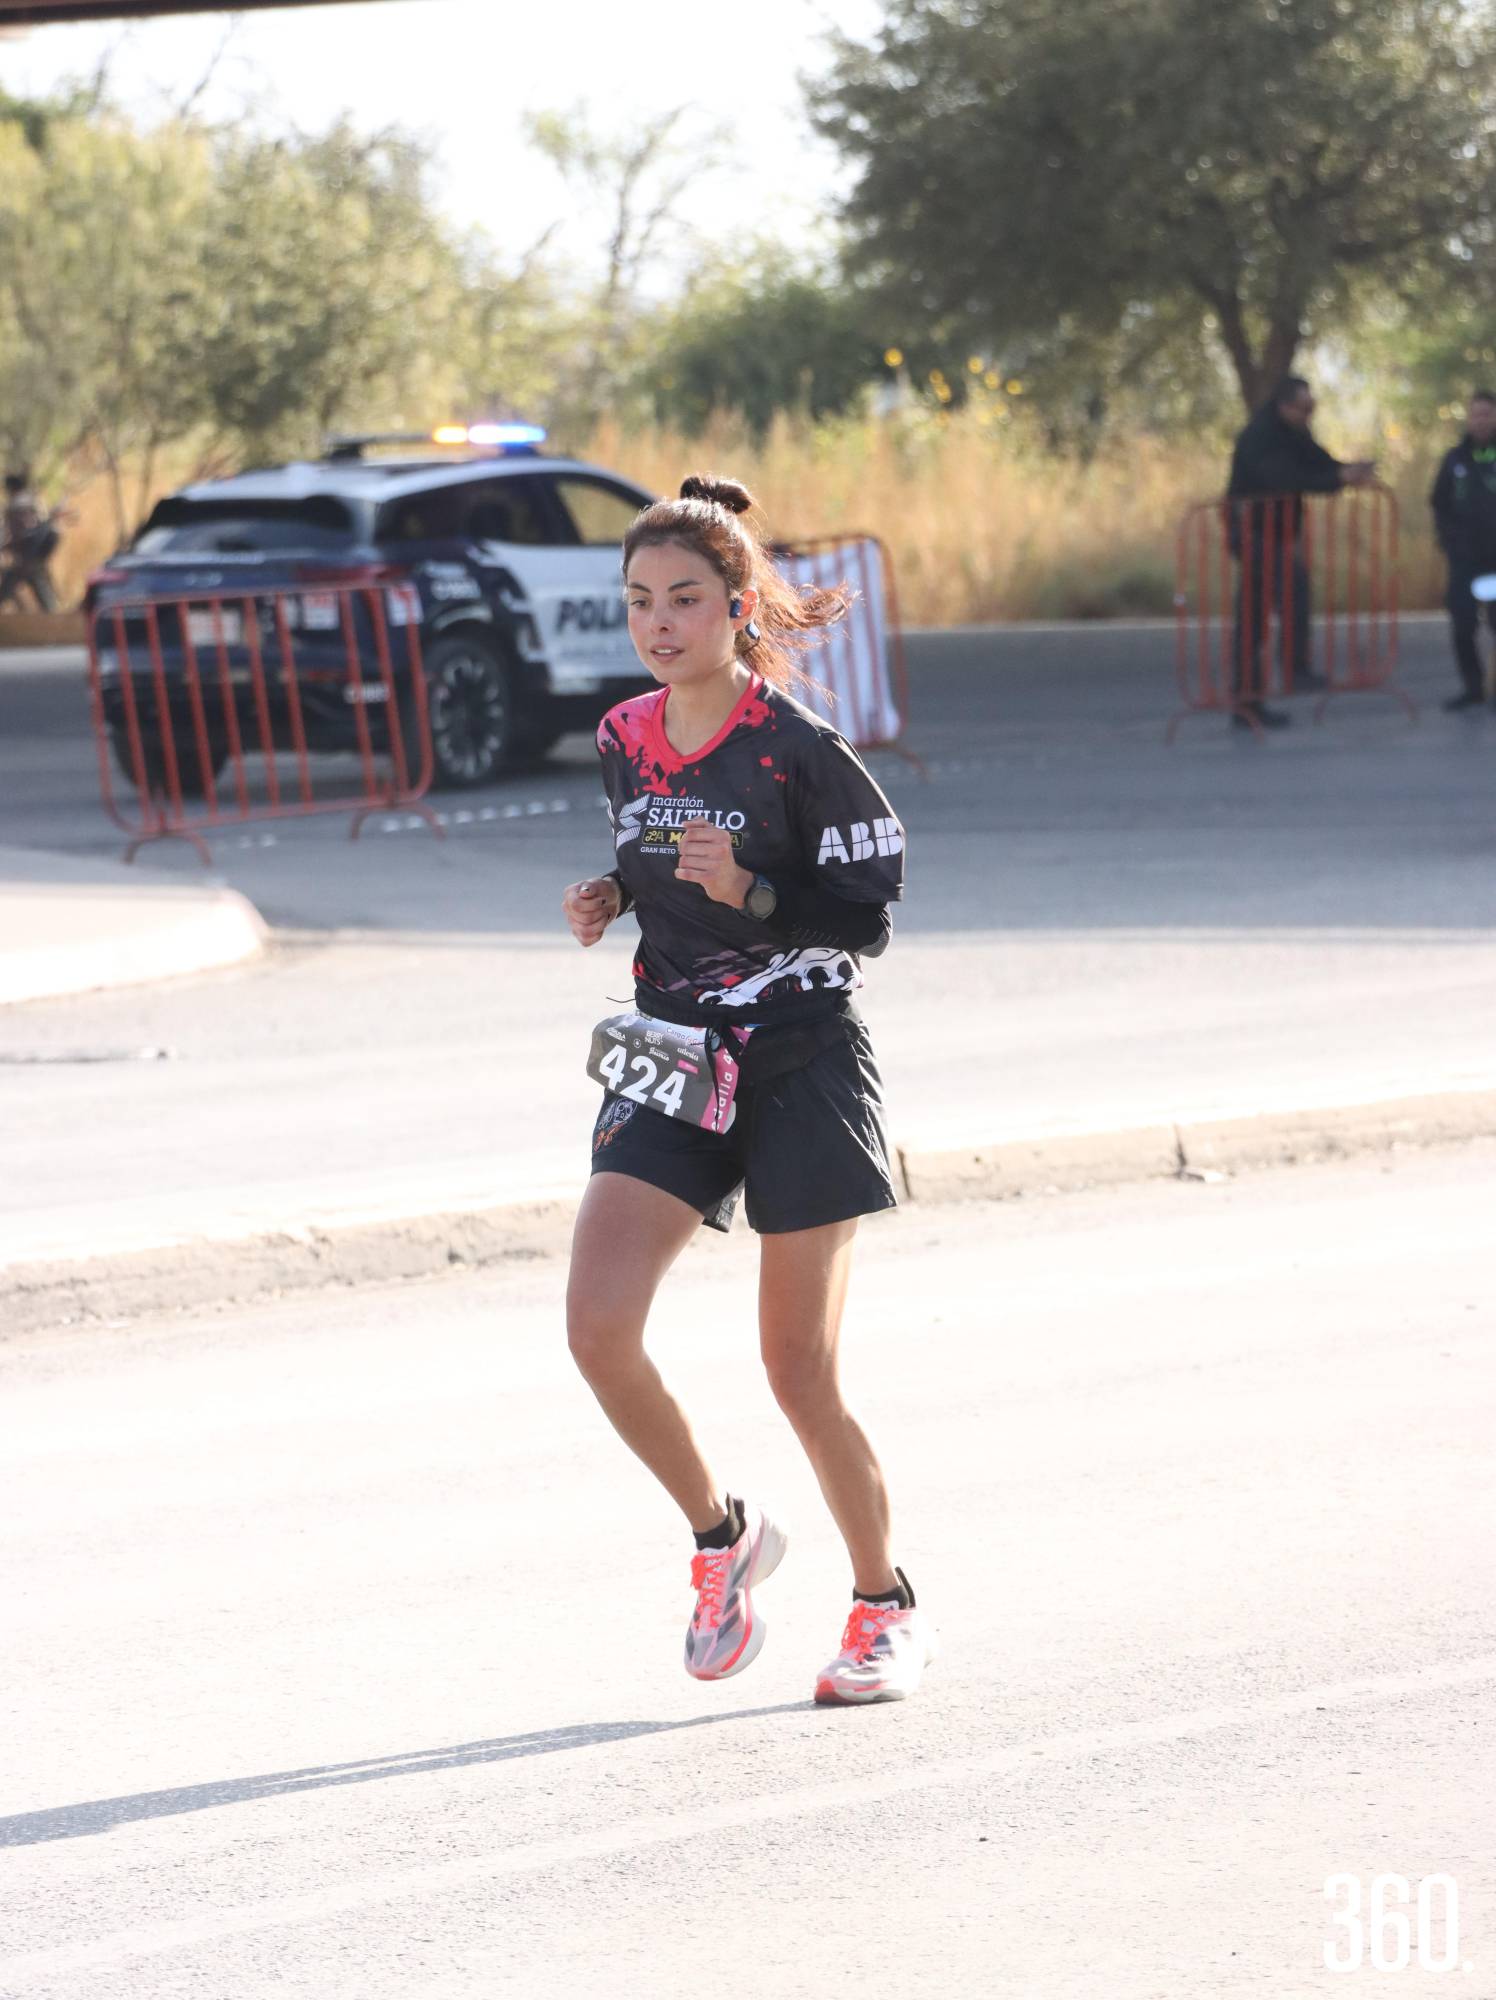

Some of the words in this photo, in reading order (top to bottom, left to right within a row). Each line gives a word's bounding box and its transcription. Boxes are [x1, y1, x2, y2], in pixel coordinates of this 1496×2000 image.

[652, 796, 704, 808] maratón
[817, 817, 903, 865] ABB
[599, 1044, 687, 1117] 424
